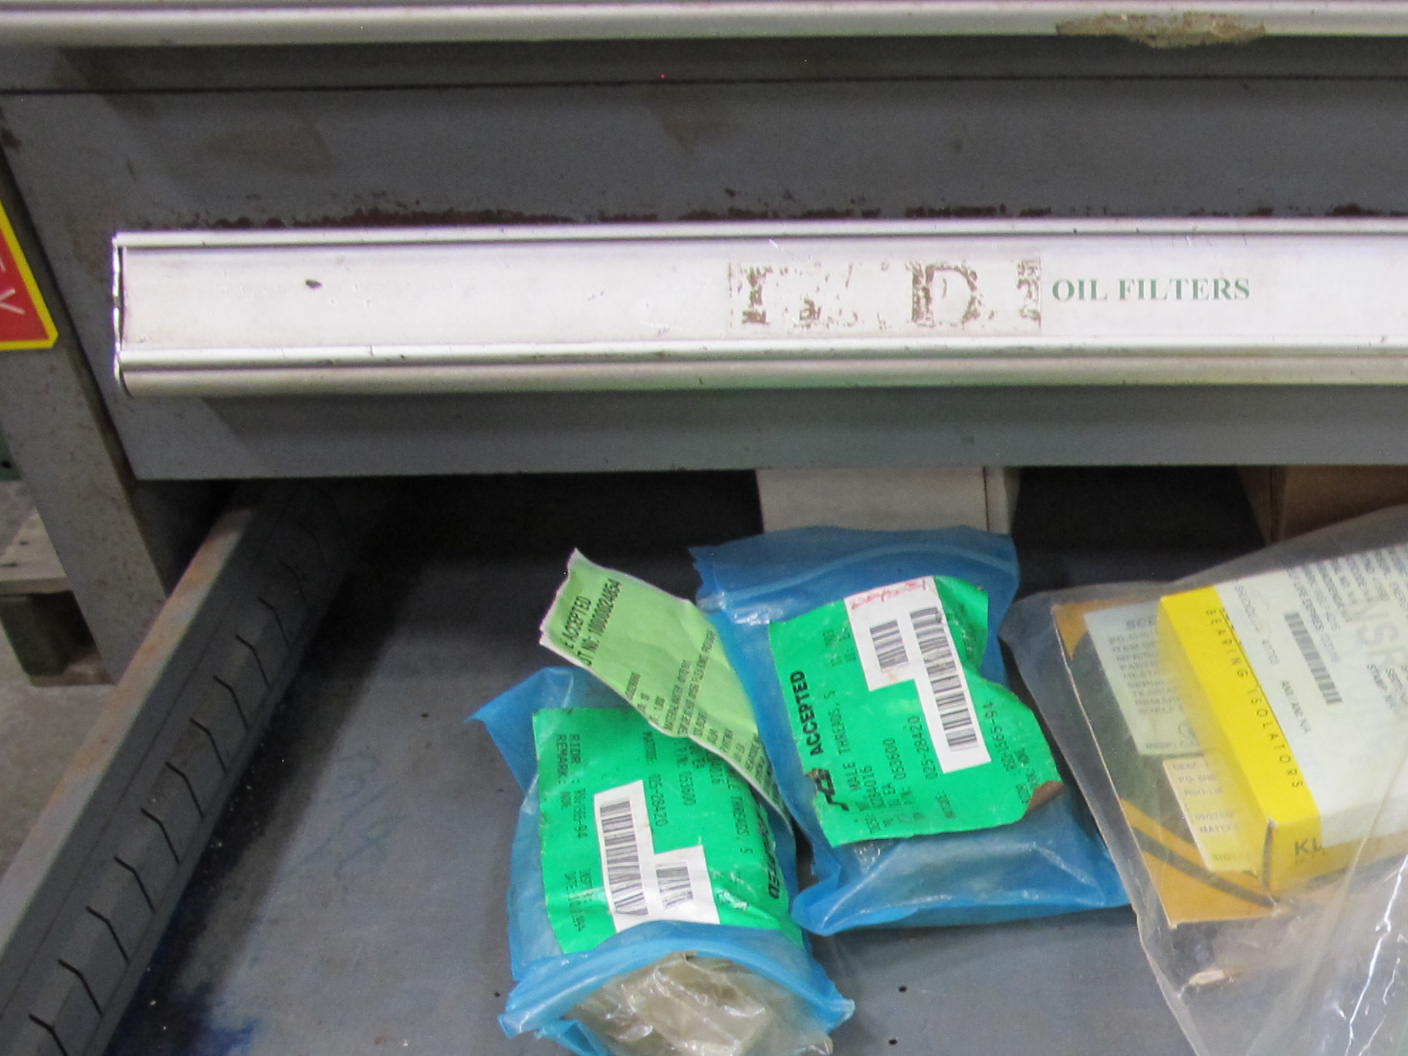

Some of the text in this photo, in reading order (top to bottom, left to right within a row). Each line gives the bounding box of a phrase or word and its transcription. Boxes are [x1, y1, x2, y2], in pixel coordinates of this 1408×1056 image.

[1052, 278, 1251, 301] OIL FILTERS
[560, 594, 592, 642] ACCEPTED
[789, 668, 823, 756] ACCEPTED
[1243, 685, 1306, 792] ISOLATORS
[907, 714, 938, 779] 025-28420
